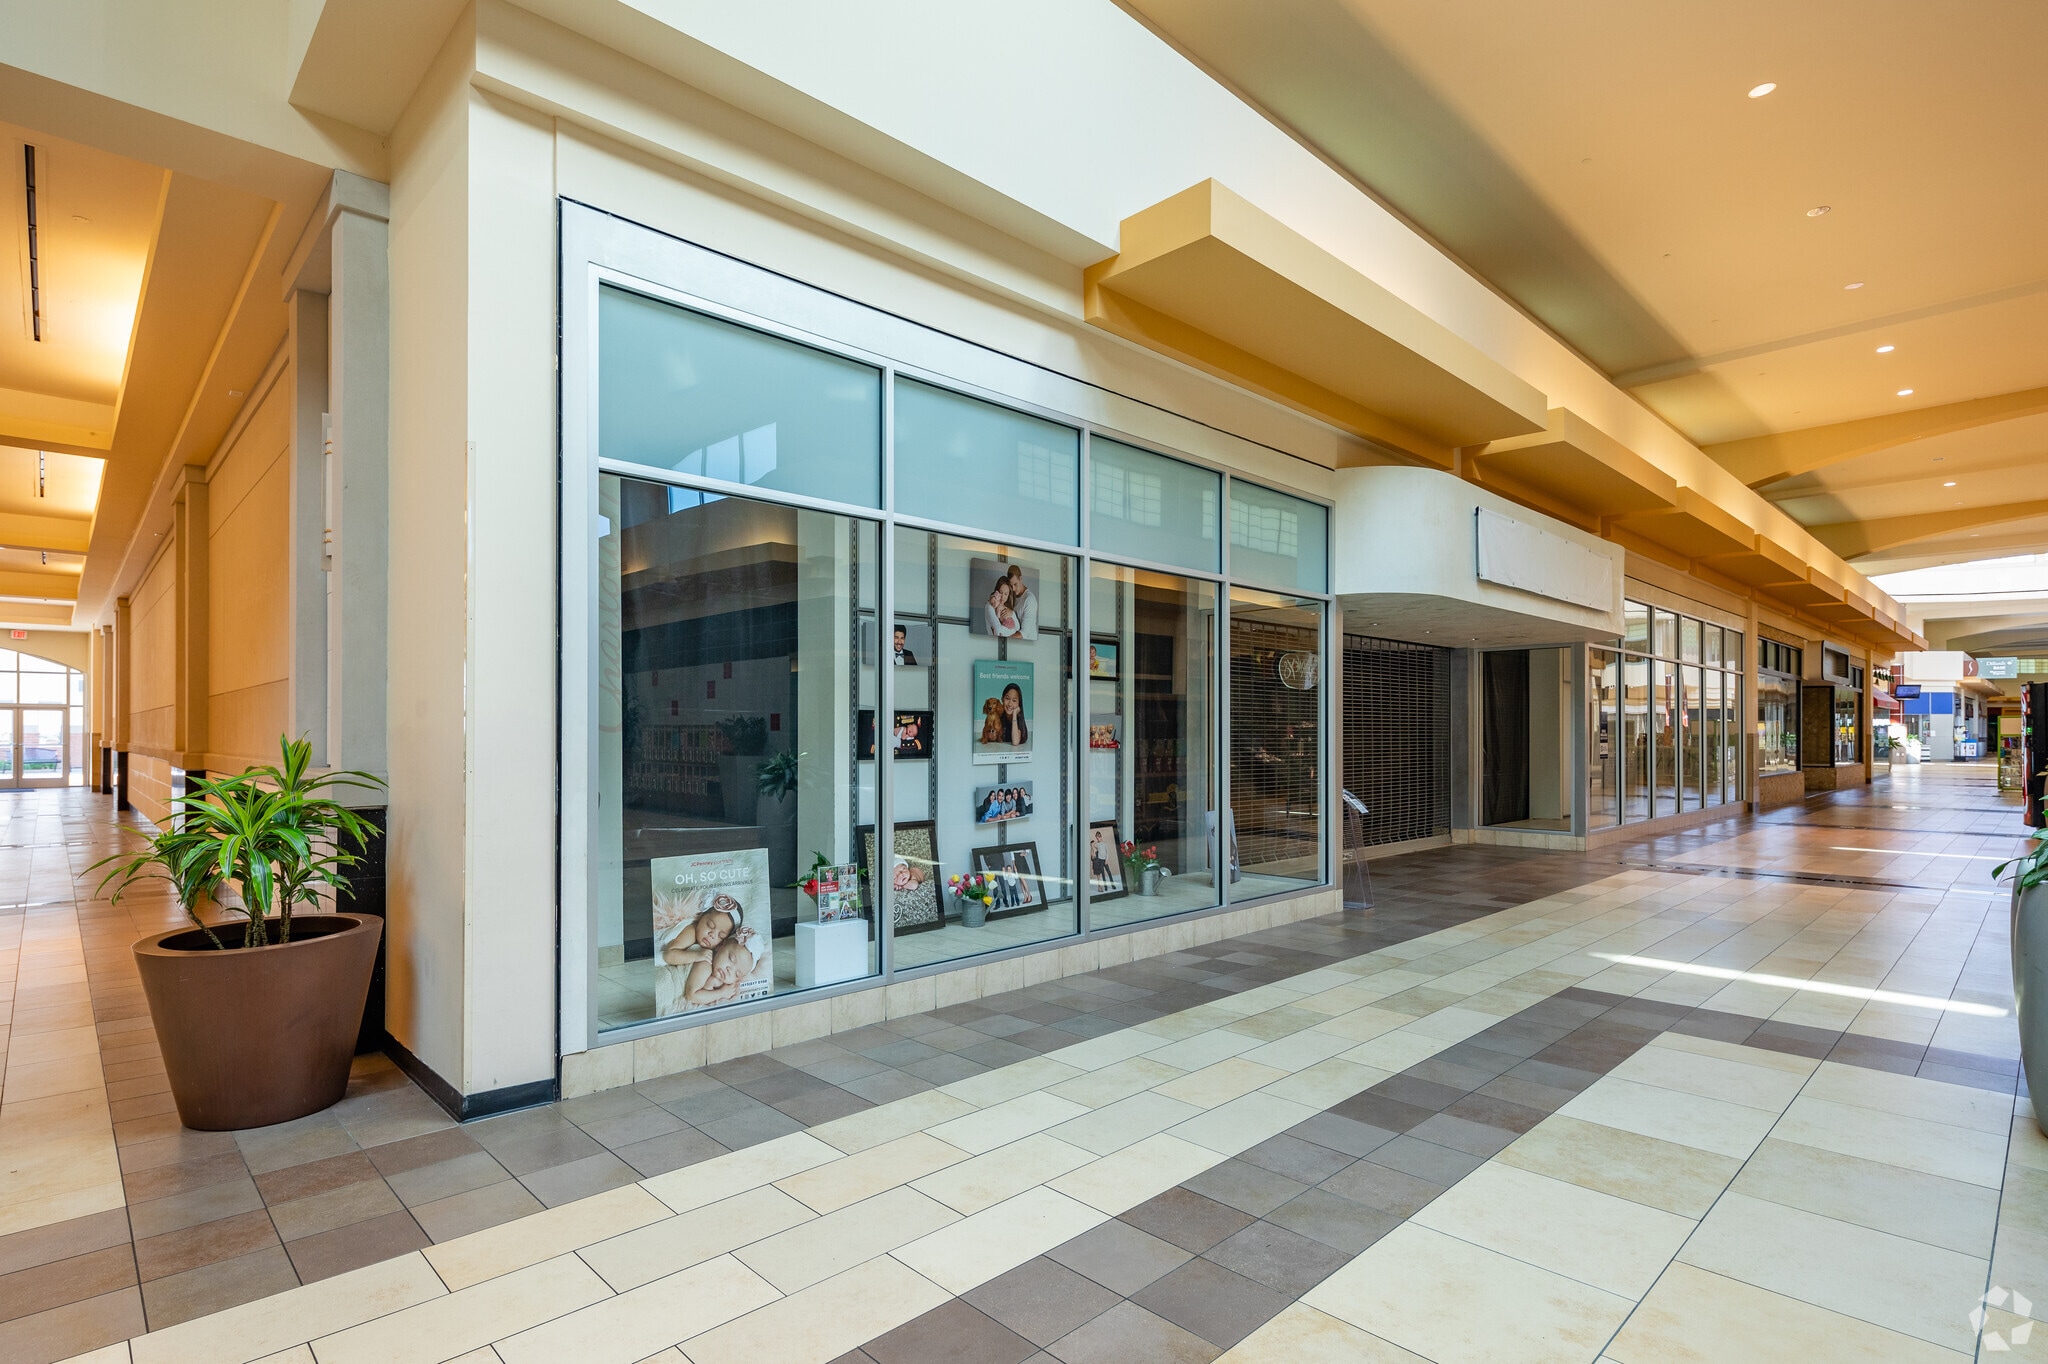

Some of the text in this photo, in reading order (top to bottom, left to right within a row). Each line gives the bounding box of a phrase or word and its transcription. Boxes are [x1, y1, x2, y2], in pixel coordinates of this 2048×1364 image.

[675, 867, 750, 885] OH, SO CUTE
[671, 879, 754, 894] CELEBRATE YOUR SPRING ARRIVALS
